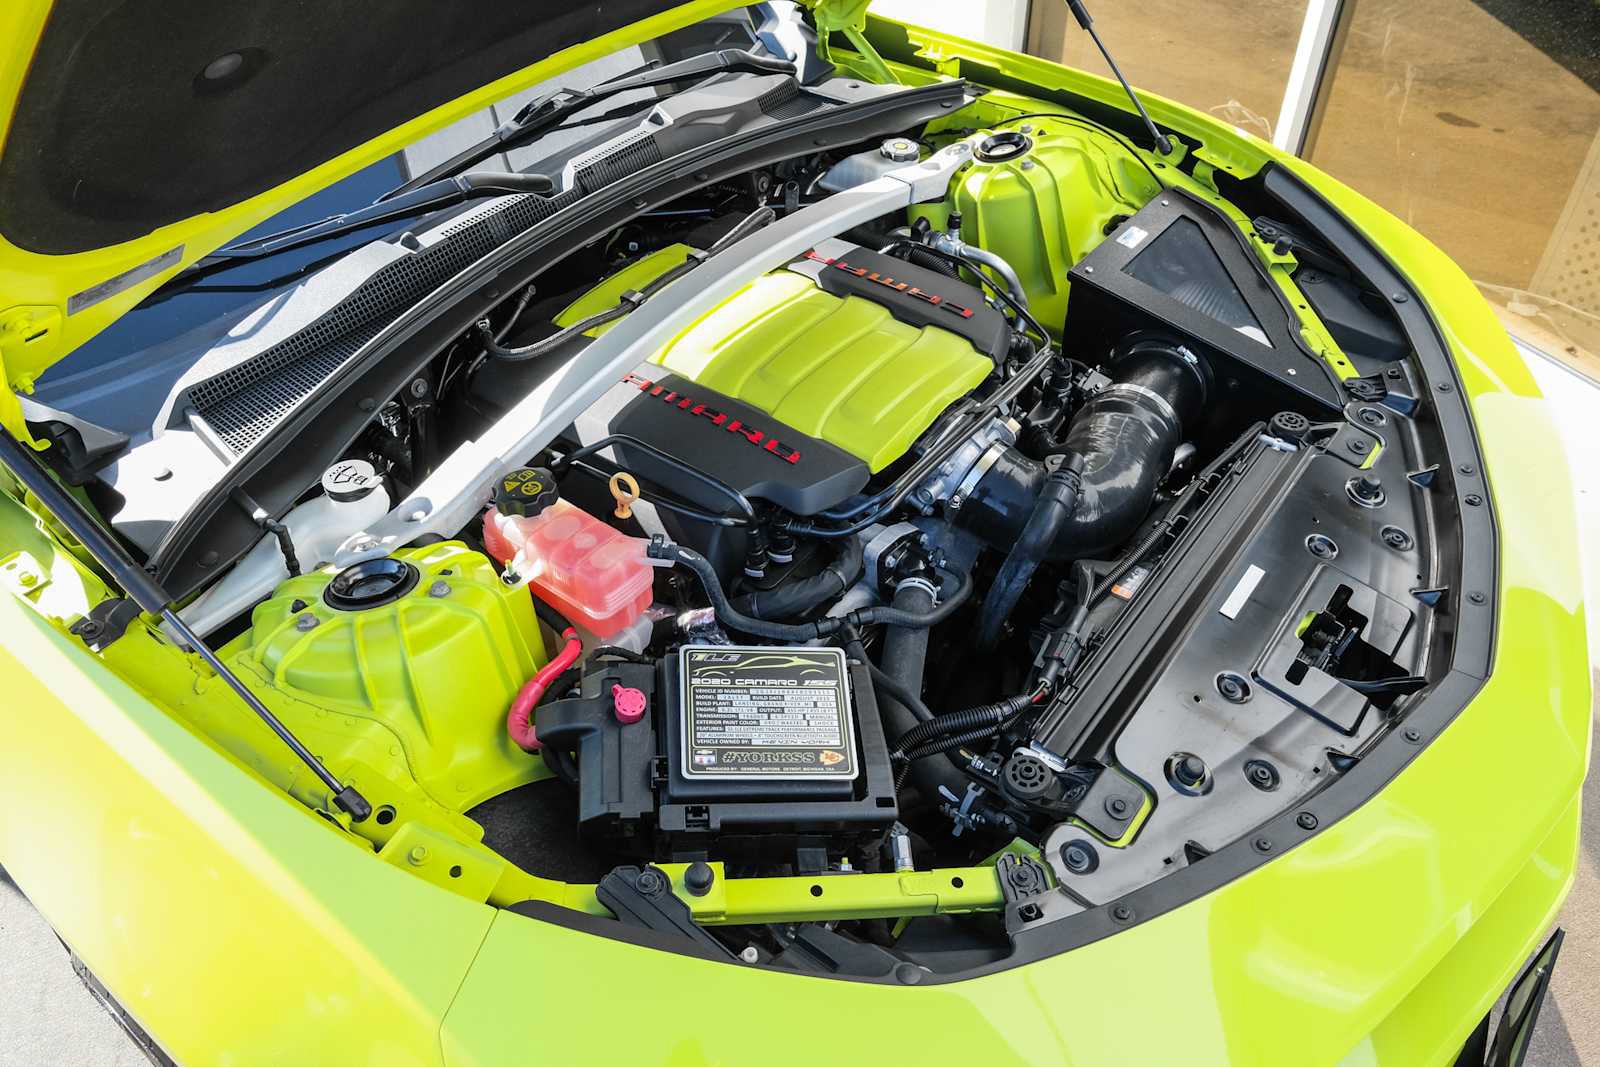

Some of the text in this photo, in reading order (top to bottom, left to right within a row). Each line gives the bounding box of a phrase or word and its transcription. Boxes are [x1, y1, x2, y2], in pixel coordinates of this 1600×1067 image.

[803, 248, 974, 320] CAMAR
[622, 373, 801, 464] AMARO
[691, 653, 741, 662] 1LE
[722, 751, 816, 764] #YORKSS
